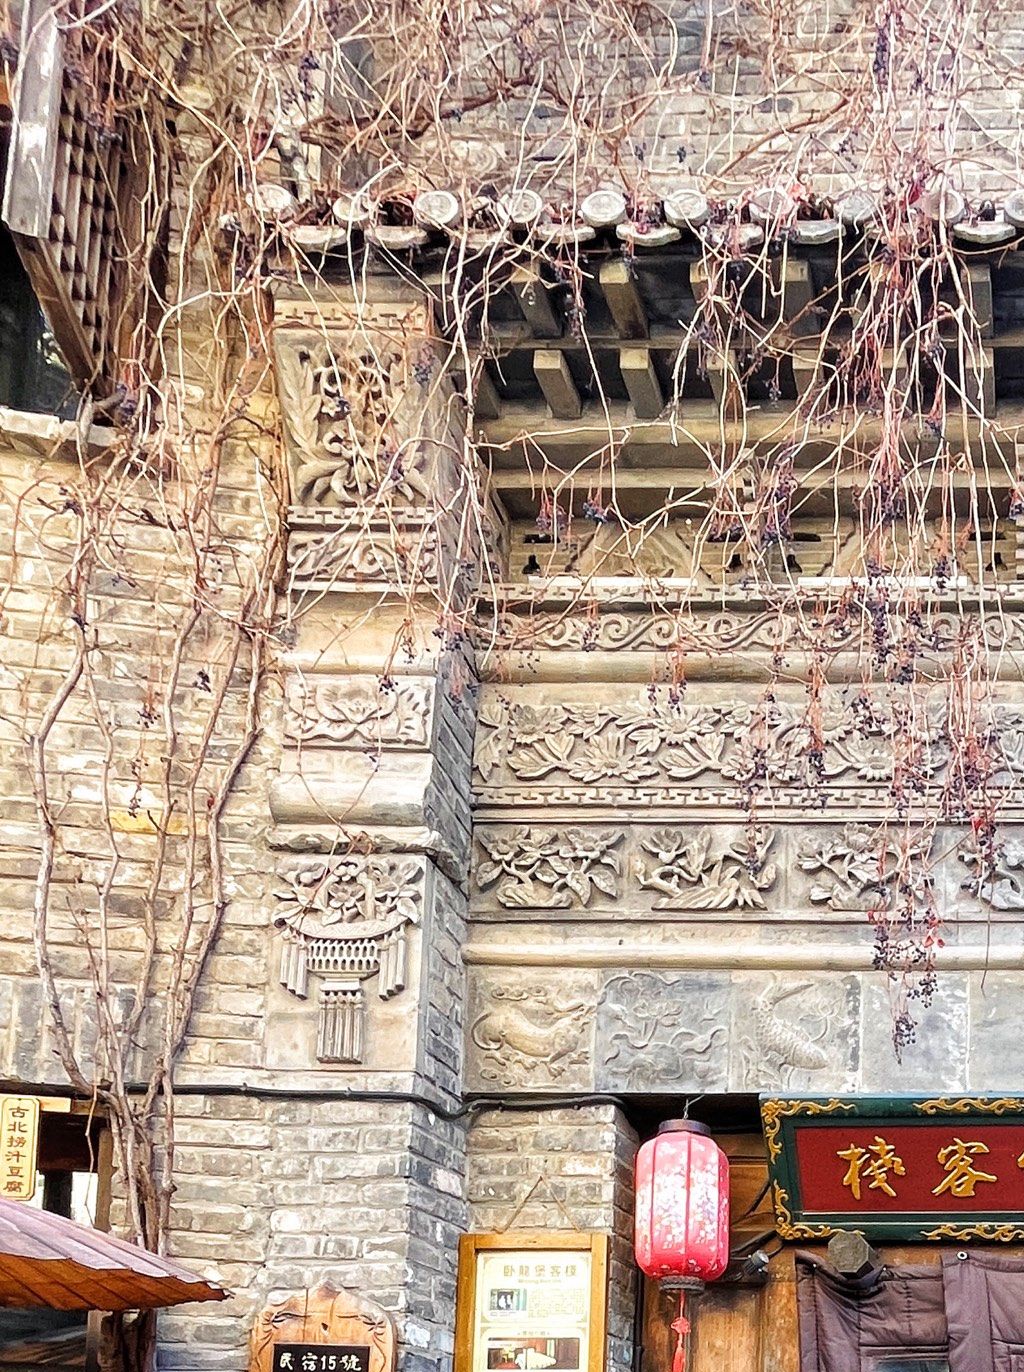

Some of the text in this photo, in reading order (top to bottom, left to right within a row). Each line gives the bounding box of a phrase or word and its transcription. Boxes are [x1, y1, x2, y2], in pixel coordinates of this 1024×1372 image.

[3, 1106, 29, 1192] 古北捞汁豆腐
